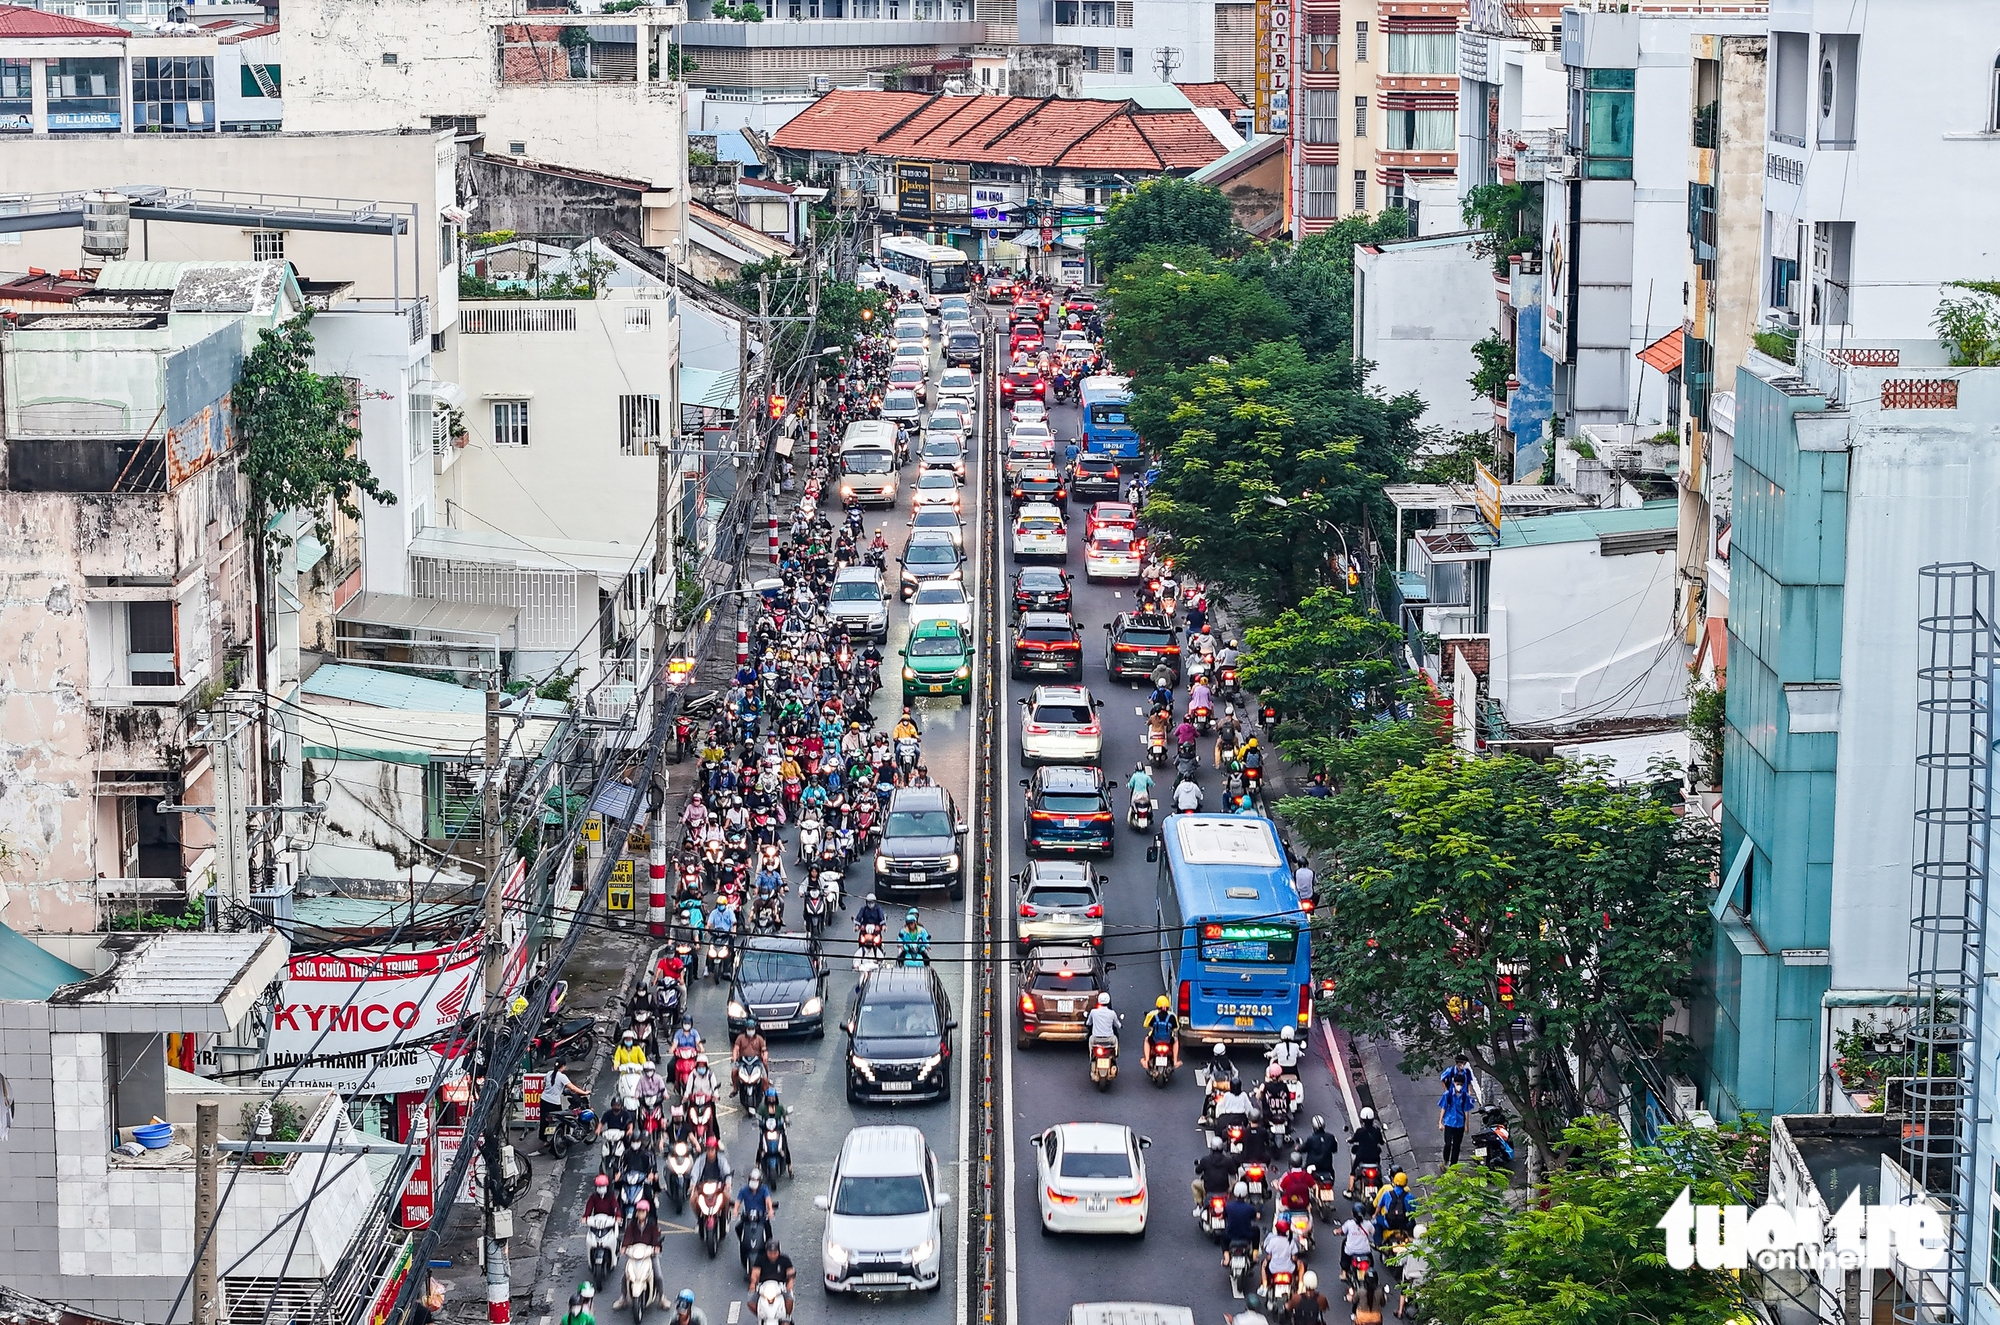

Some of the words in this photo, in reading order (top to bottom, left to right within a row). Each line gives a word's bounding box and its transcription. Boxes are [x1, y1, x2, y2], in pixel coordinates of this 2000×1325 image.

[55, 114, 112, 124] BILLIARDS
[585, 822, 599, 831] XAY
[1206, 926, 1220, 937] 20
[319, 960, 347, 979] CHỮA
[349, 960, 384, 979] THÀNH
[386, 958, 419, 977] TRUNG
[274, 1000, 421, 1033] KYMCO
[371, 1051, 418, 1069] TRUNG
[524, 1079, 540, 1090] THAY
[406, 1178, 429, 1196] THÀNH
[406, 1205, 430, 1222] TRUNG
